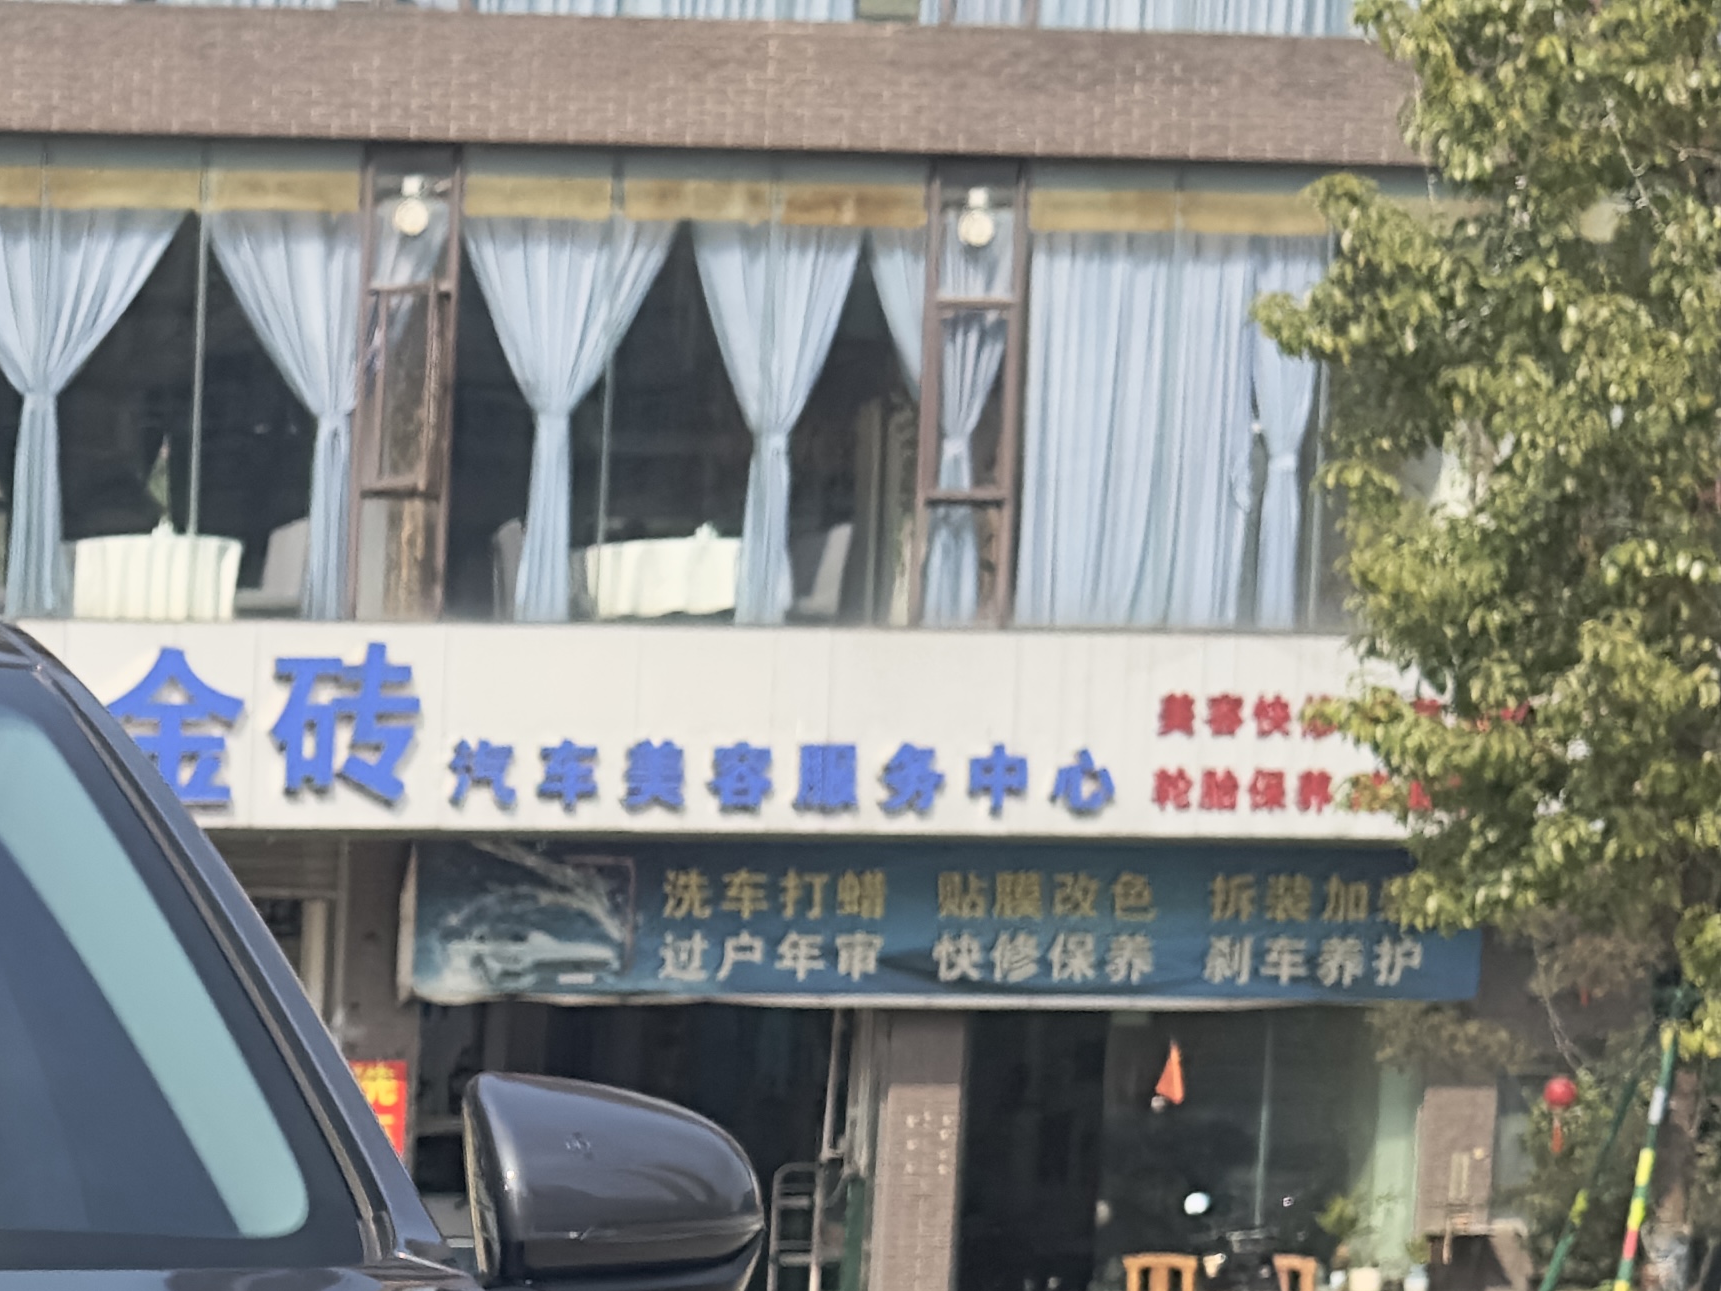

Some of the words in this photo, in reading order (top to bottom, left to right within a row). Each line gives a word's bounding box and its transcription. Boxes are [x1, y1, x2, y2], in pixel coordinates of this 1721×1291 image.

[105, 642, 423, 812] 金砖
[447, 738, 1117, 815] 汽车美容服务中心
[662, 867, 887, 921] 洗车打蜡
[937, 869, 1156, 922] 贴膜改色
[659, 931, 884, 982] 过户年审
[932, 932, 1154, 985] 快修保养
[1202, 932, 1424, 988] 刹车养护
